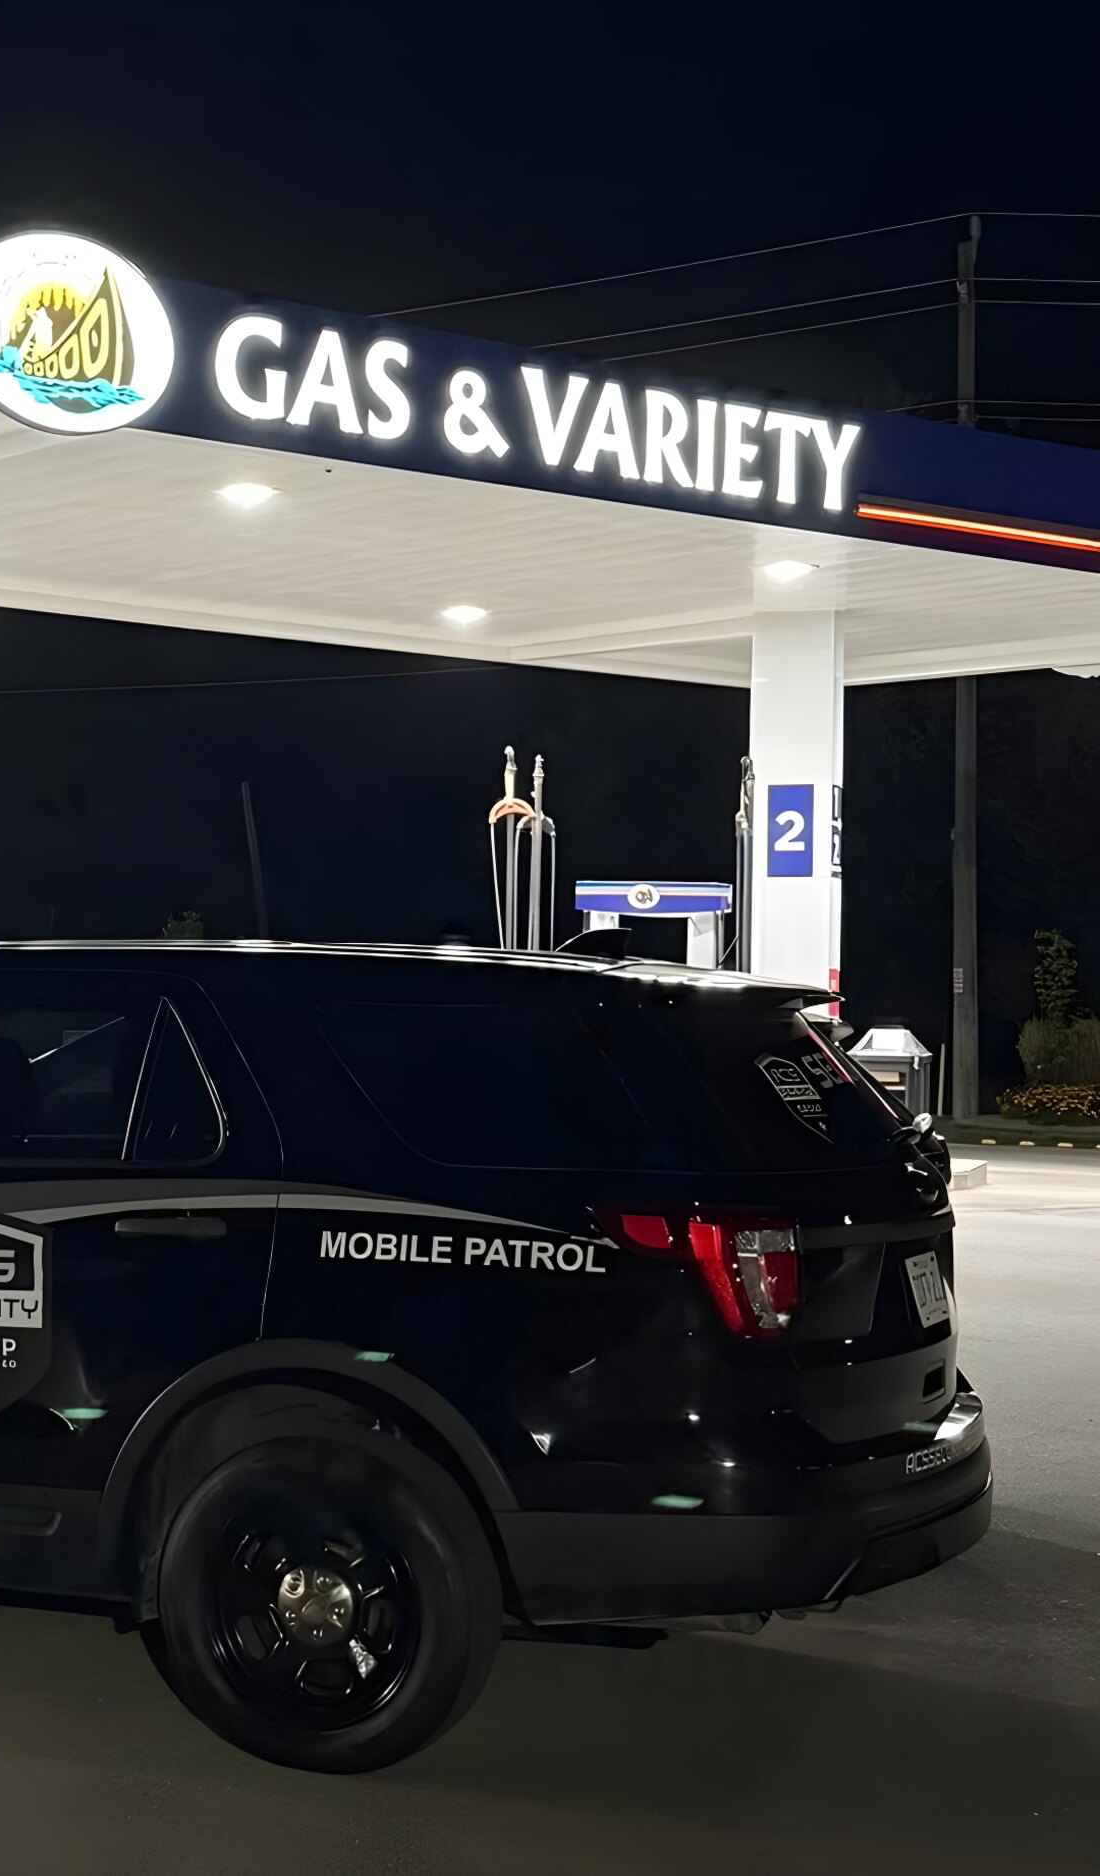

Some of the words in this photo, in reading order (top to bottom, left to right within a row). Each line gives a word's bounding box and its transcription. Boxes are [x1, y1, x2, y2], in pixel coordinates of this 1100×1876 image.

[214, 316, 411, 440] GAS
[443, 371, 509, 457] &
[520, 365, 861, 511] VARIETY
[774, 810, 805, 851] 2
[320, 1230, 453, 1264] MOBILE
[464, 1237, 606, 1273] PATROL
